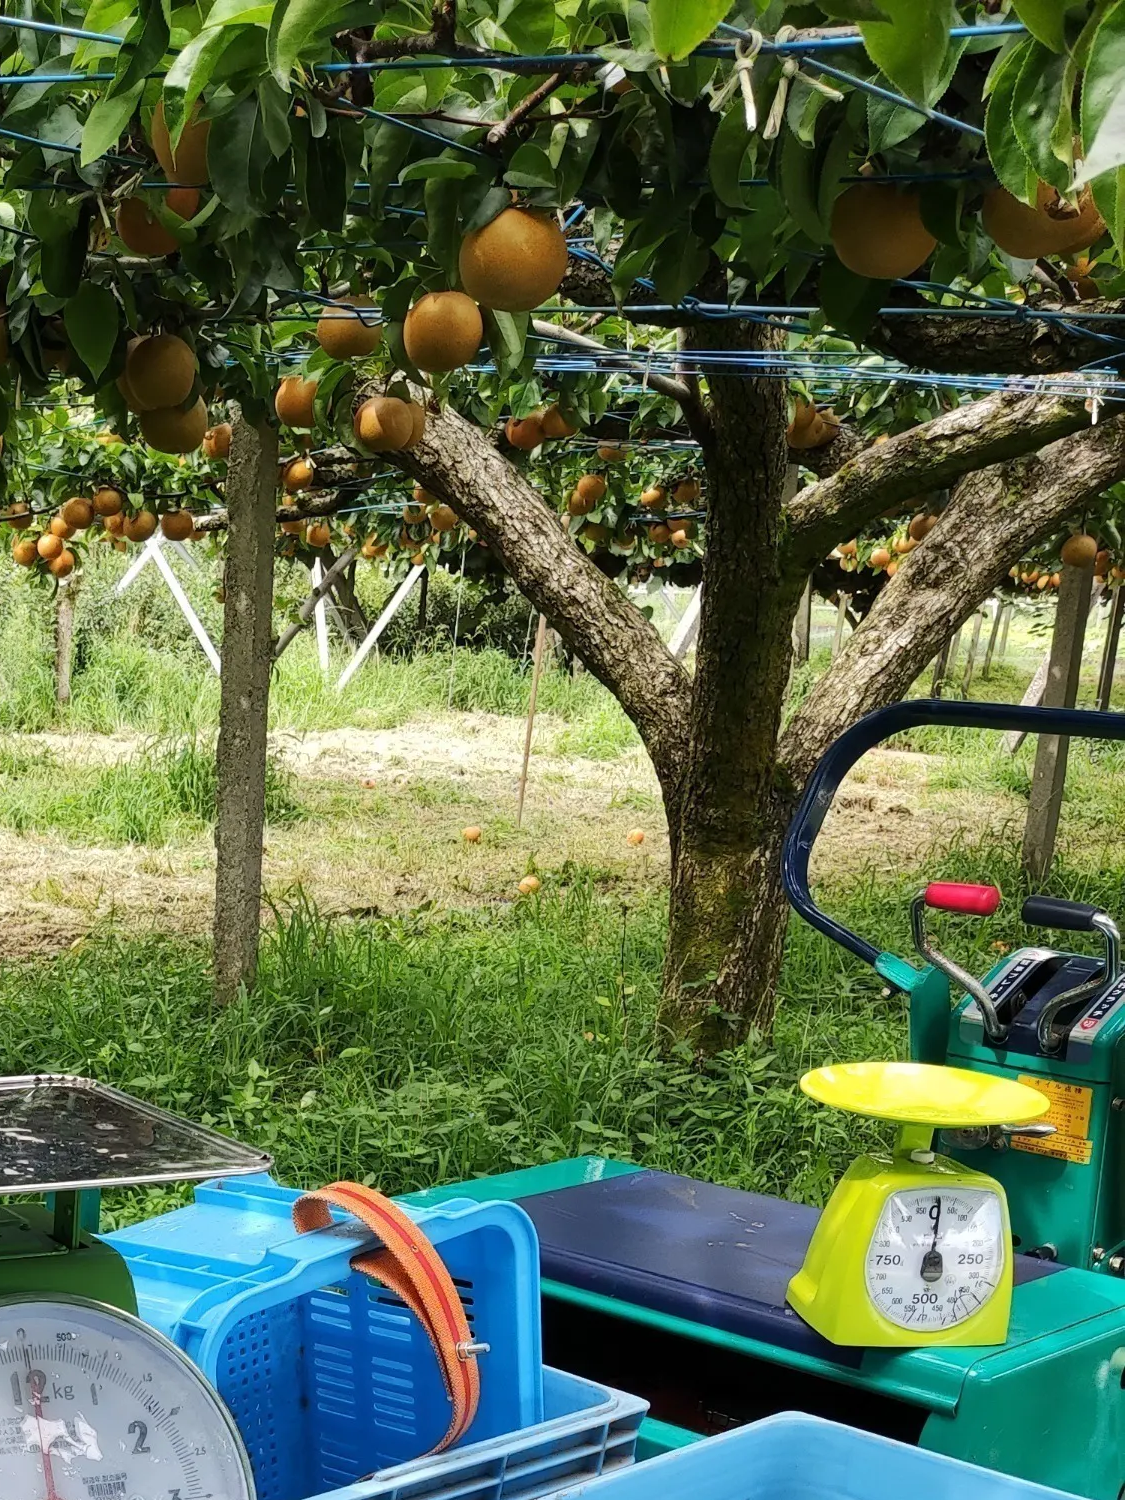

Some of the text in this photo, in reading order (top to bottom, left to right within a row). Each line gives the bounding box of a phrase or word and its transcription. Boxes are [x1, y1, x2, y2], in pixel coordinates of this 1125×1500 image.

[957, 1254, 984, 1265] 250
[911, 1293, 938, 1304] 500
[52, 1382, 75, 1400] kg
[127, 1420, 151, 1455] 2
